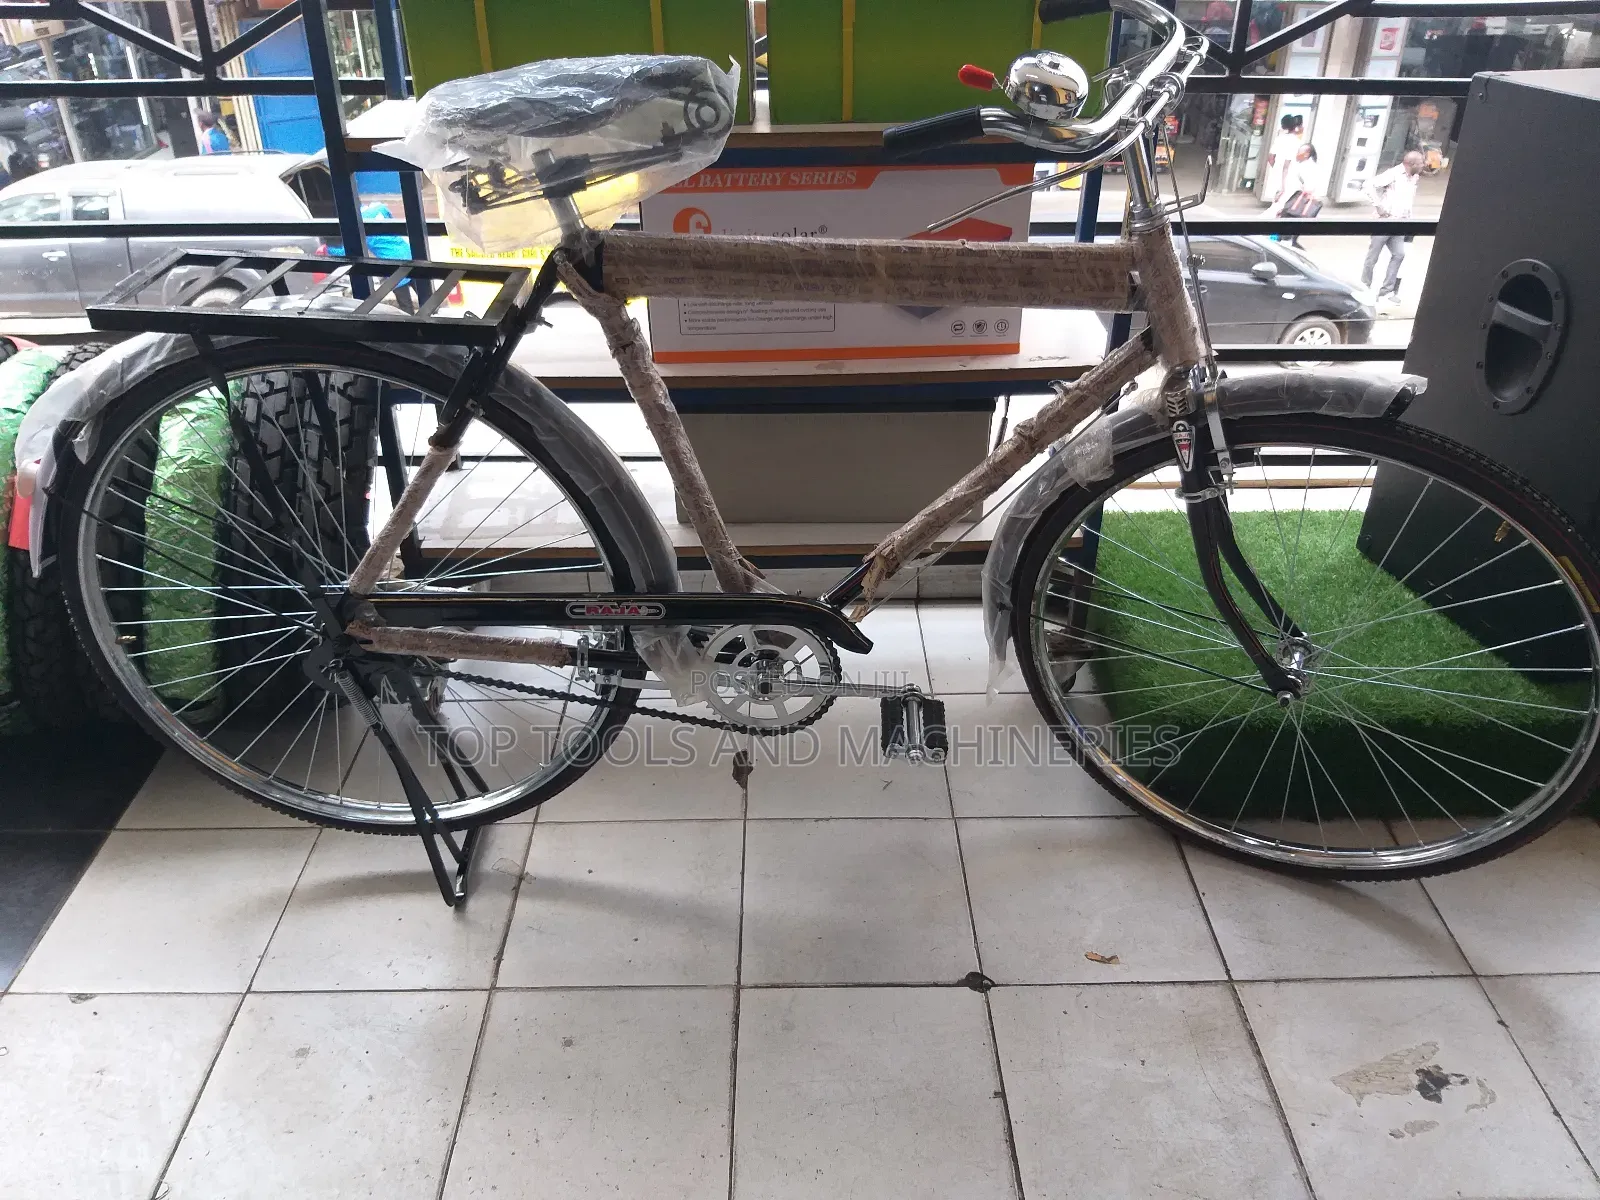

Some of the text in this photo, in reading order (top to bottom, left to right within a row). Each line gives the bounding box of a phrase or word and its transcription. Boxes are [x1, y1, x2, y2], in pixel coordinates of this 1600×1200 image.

[699, 172, 784, 188] BATTERY
[788, 169, 857, 185] SERIES
[585, 604, 641, 616] RAJA
